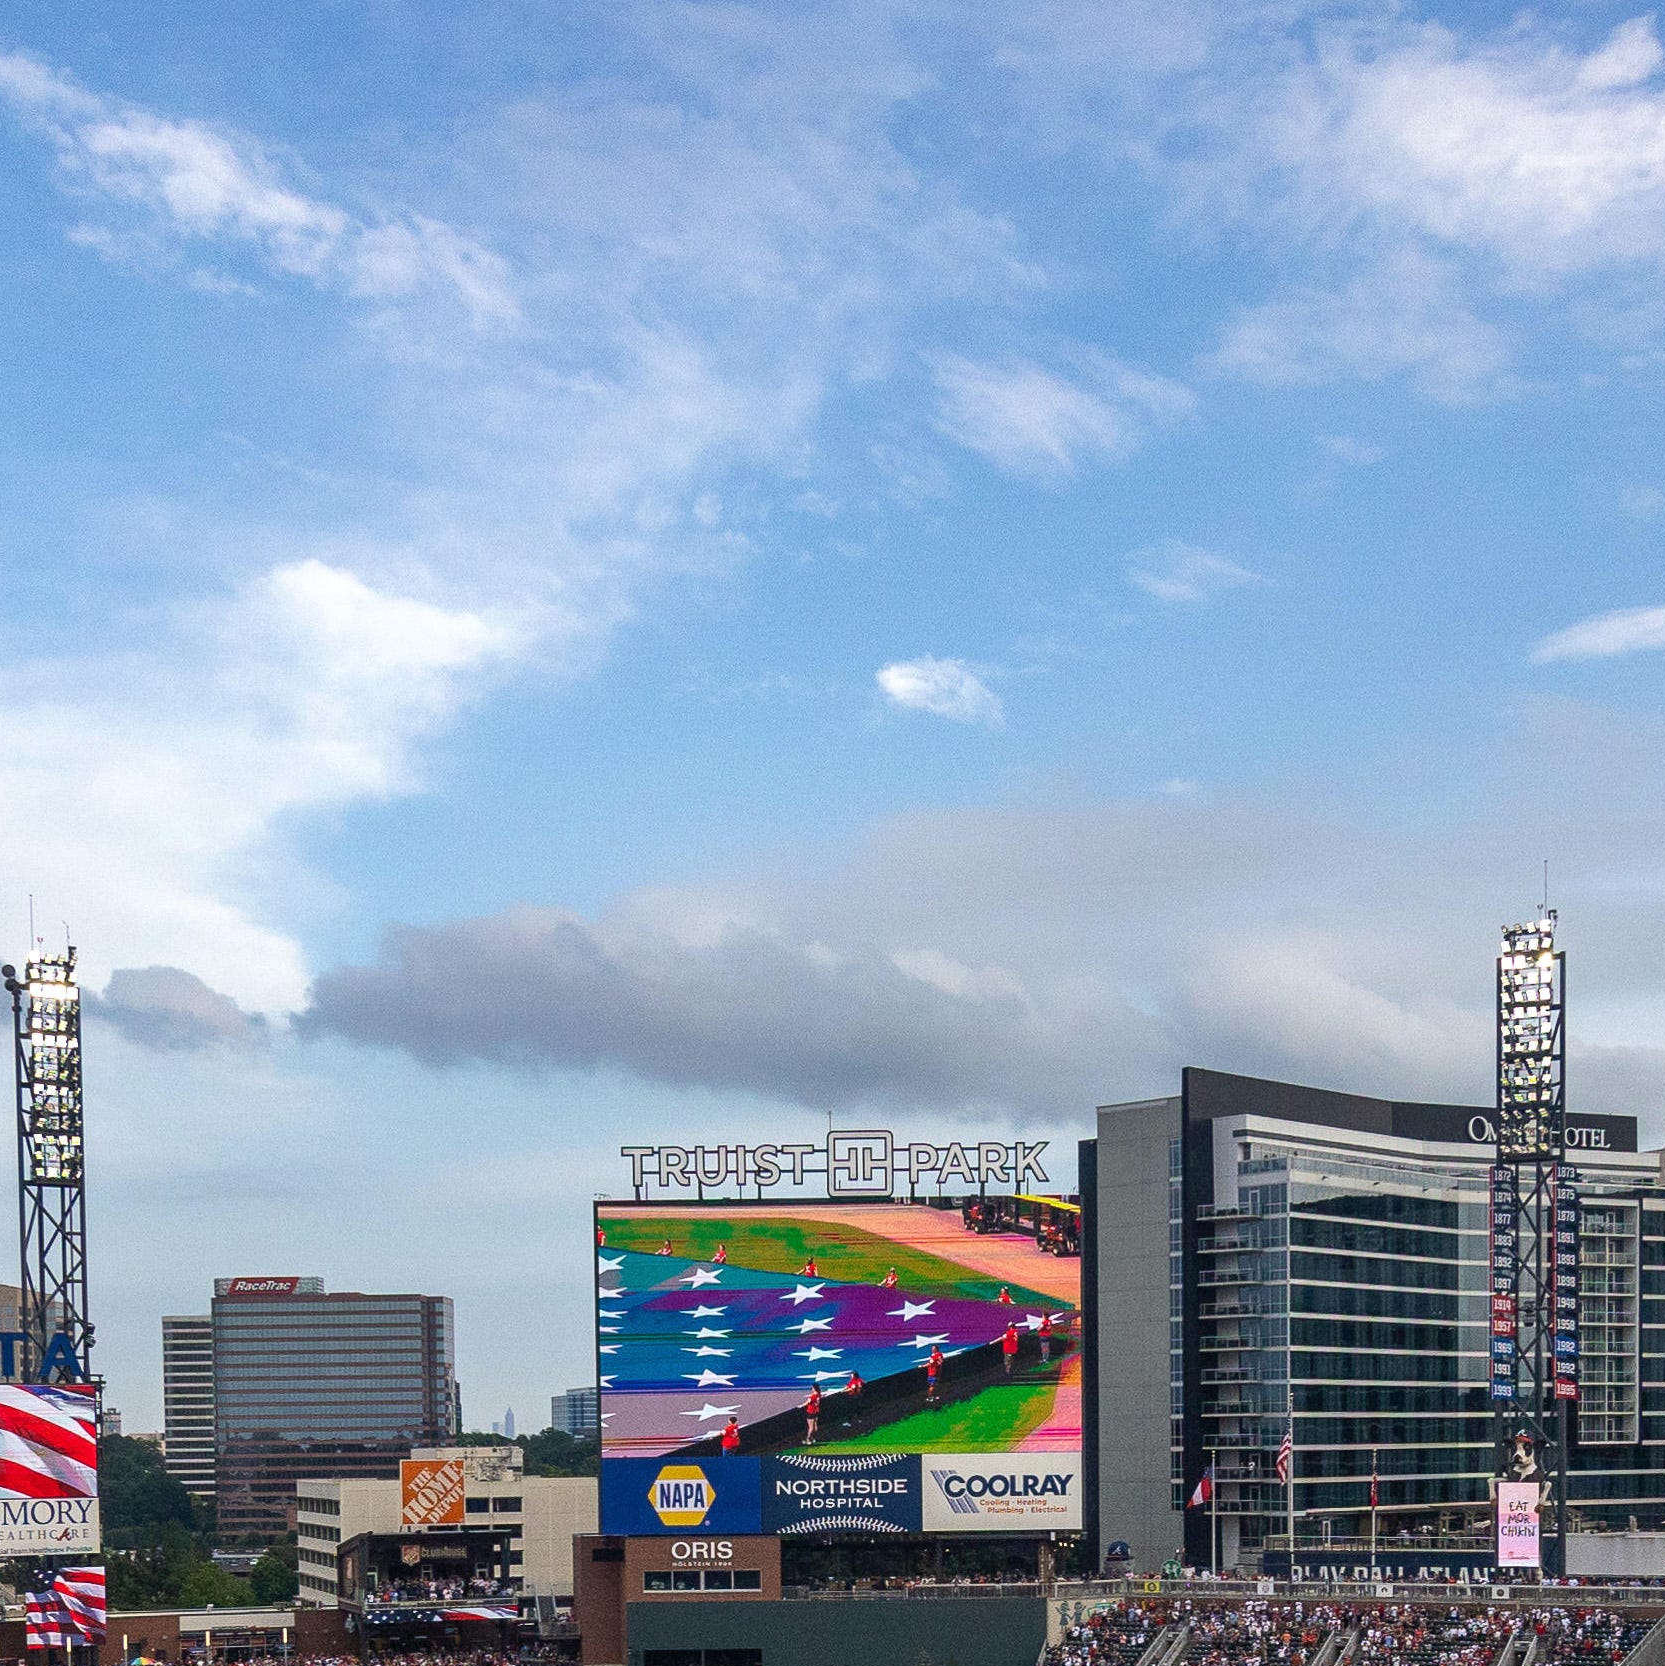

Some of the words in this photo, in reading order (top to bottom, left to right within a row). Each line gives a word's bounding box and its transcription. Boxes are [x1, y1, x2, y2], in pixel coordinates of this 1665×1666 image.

[1553, 1127, 1611, 1148] OTEL
[621, 1145, 814, 1188] TRUIST
[908, 1141, 1050, 1184] PARK
[235, 1281, 291, 1291] RaceTrac
[1493, 1321, 1511, 1333] 1957
[407, 1467, 434, 1492] THE
[776, 1478, 908, 1495] NORTHSIDE
[944, 1474, 1074, 1497] COOLRAY
[403, 1461, 463, 1524] HOME
[658, 1483, 706, 1509] NAPA
[427, 1483, 464, 1523] DEPOT
[800, 1498, 884, 1509] HOSPITAL
[1509, 1501, 1528, 1512] EAT
[1508, 1514, 1530, 1524] MOR
[1501, 1525, 1535, 1537] CHIKIN
[671, 1541, 733, 1560] ORIS
